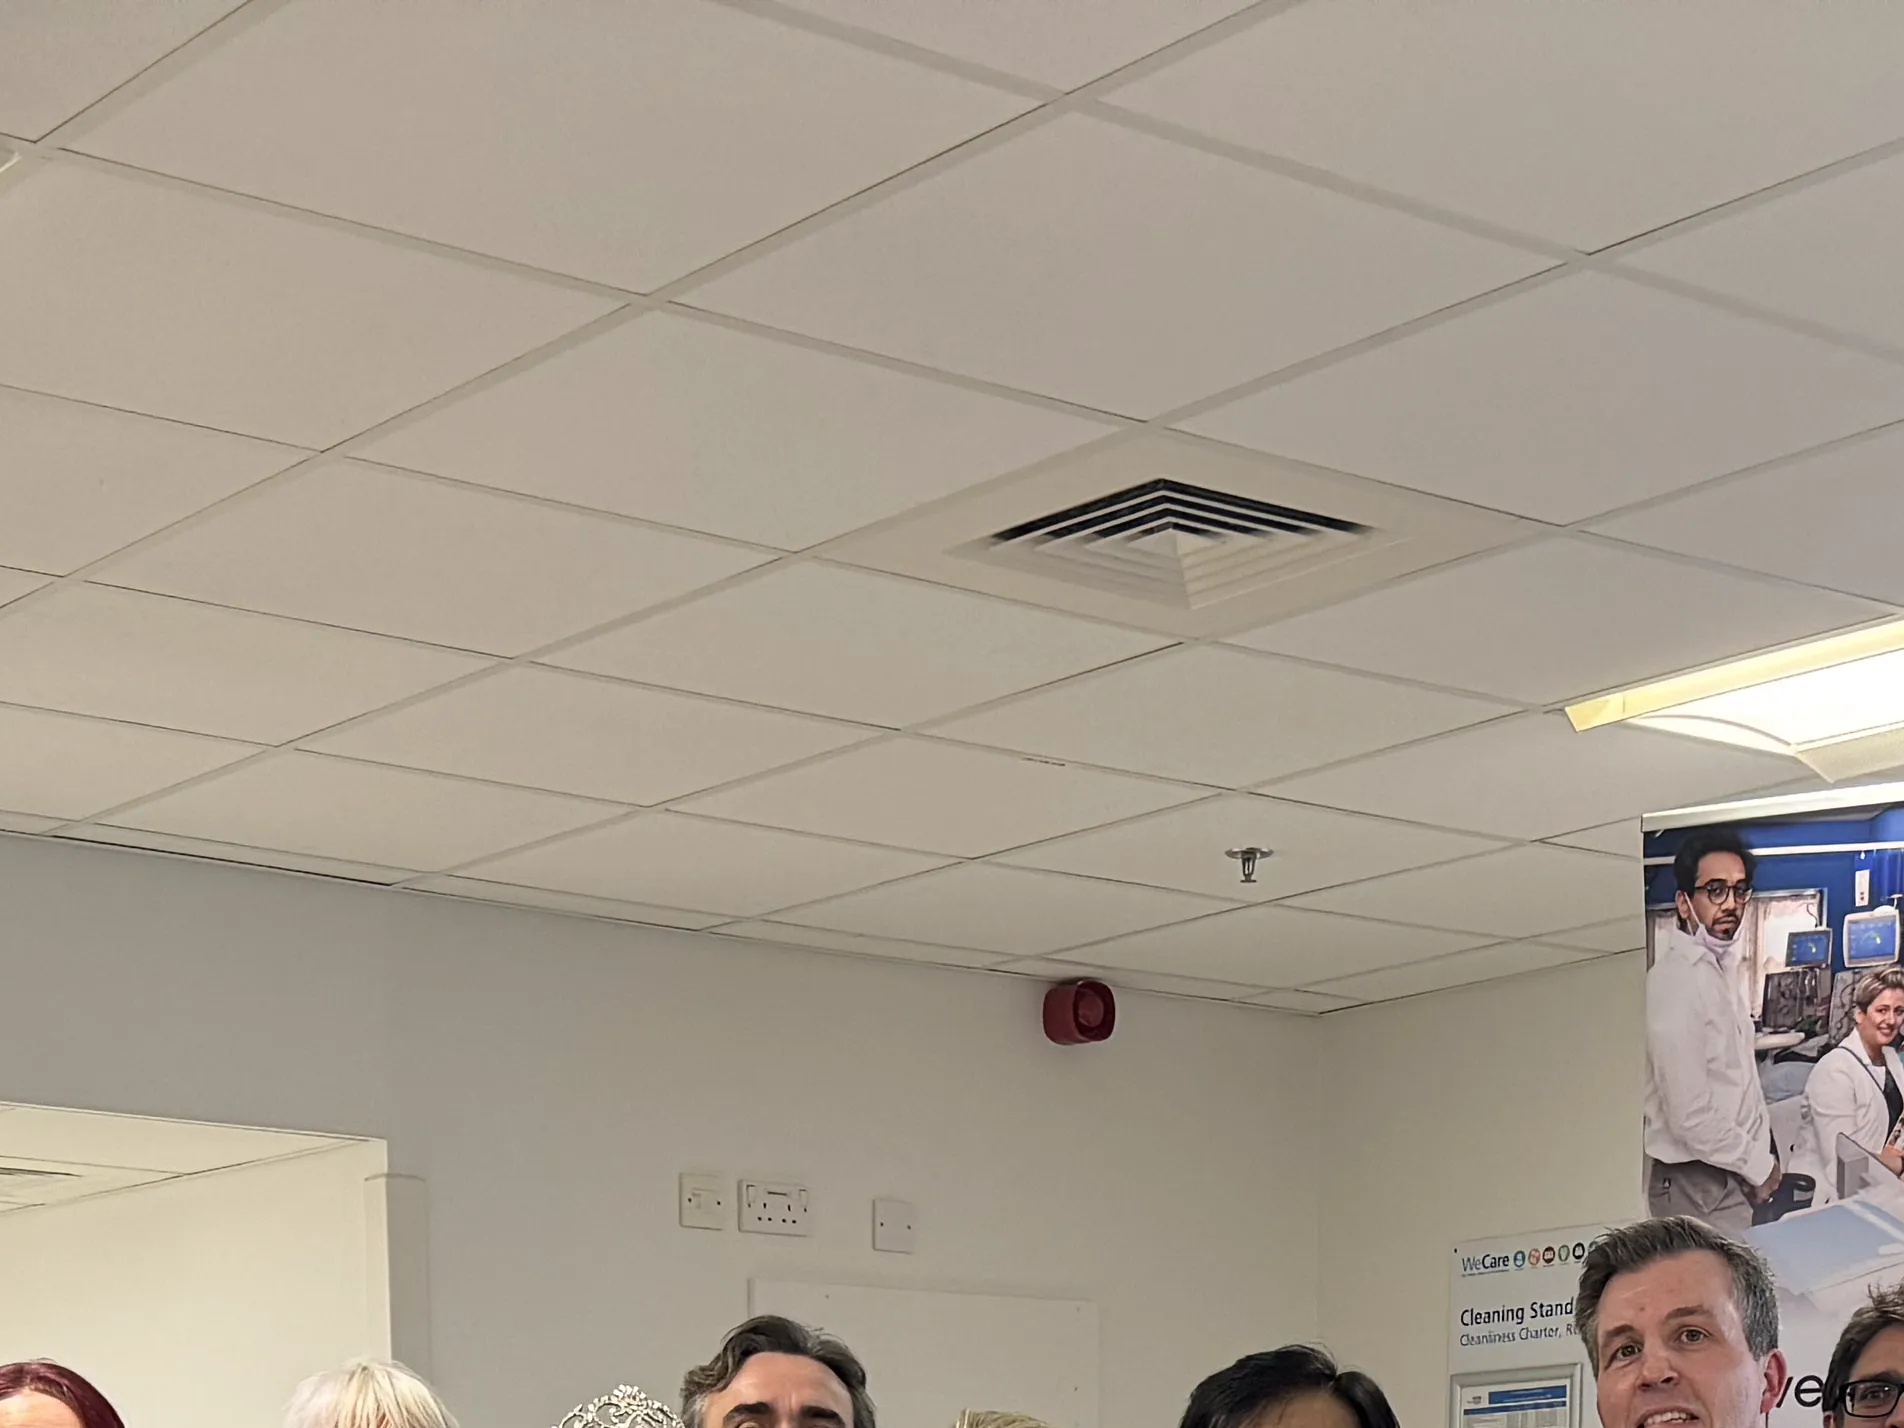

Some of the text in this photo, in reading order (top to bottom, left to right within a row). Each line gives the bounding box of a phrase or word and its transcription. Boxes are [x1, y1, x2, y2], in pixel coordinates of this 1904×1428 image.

[1461, 1253, 1510, 1272] WeCare
[1460, 1296, 1575, 1327] Cleaning Stand
